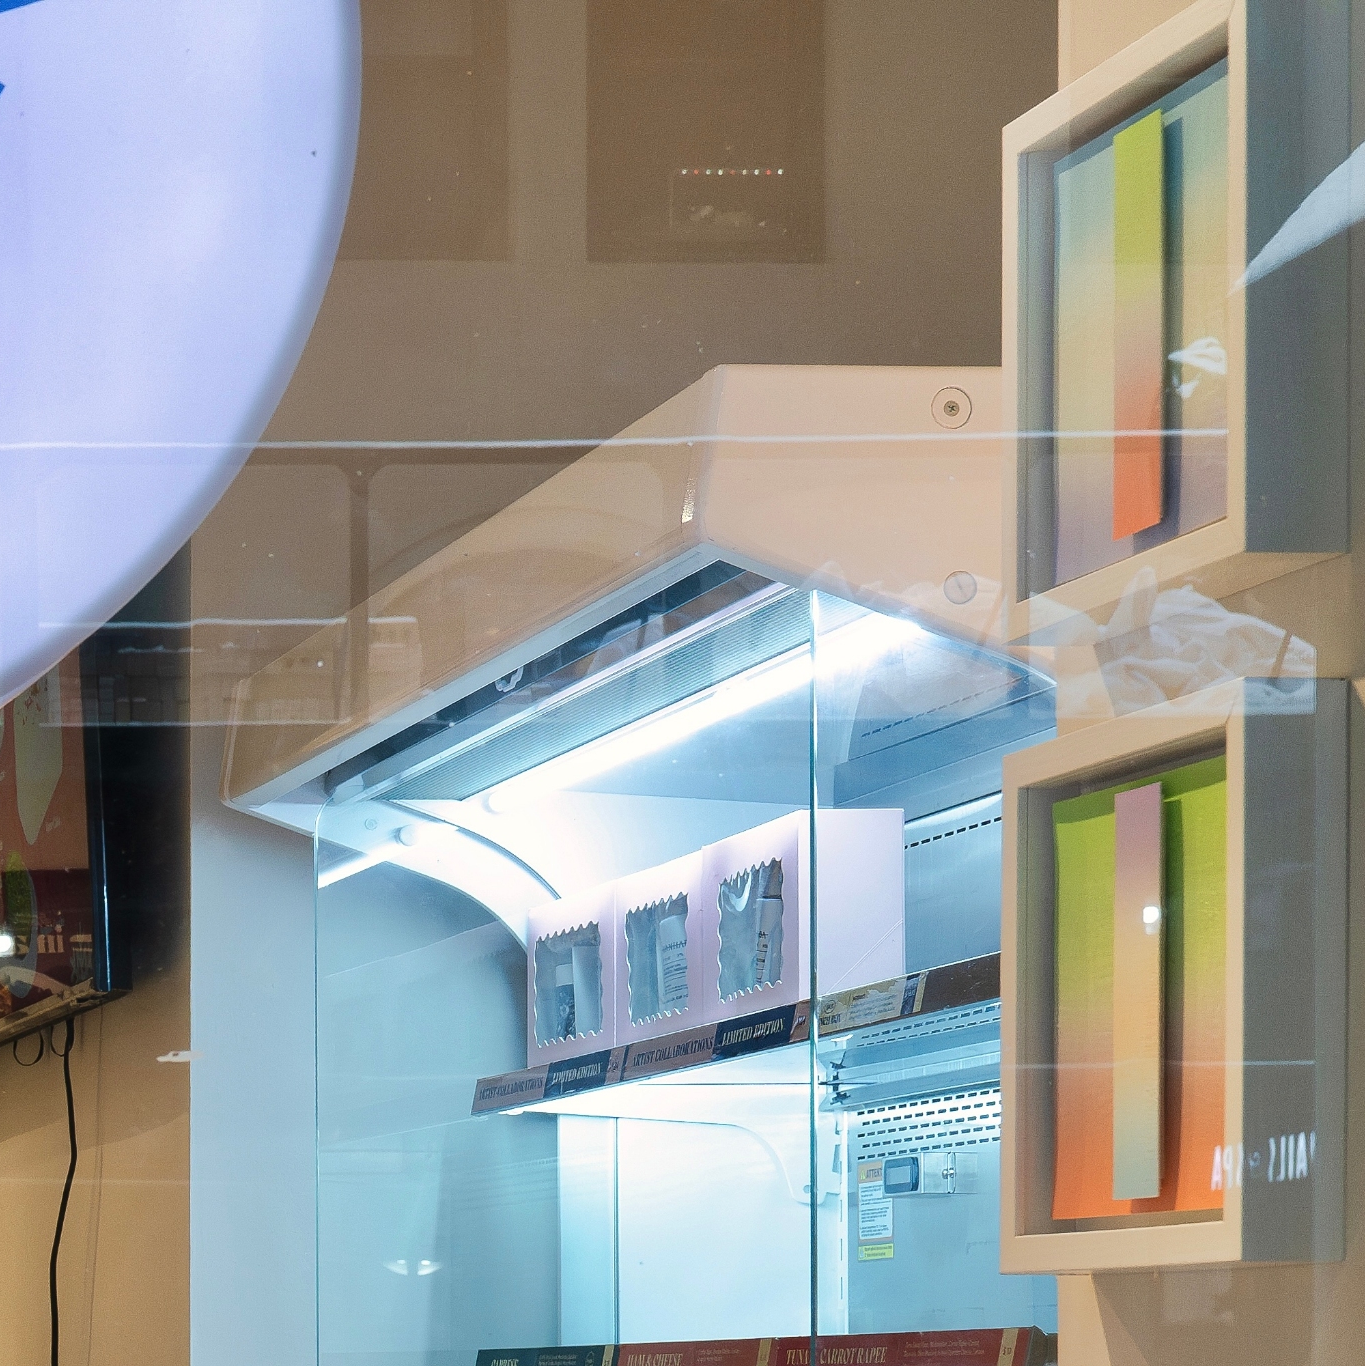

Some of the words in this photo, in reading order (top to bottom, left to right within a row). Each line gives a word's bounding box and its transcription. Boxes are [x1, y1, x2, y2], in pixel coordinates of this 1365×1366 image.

[722, 1026, 753, 1046] LIMITED
[753, 1017, 786, 1039] EDITION
[655, 1036, 715, 1063] COLLABORATIONS
[552, 1068, 578, 1084] LIMITED
[577, 1062, 602, 1080] EDITION
[786, 1349, 810, 1365] TUNA
[820, 1347, 856, 1364] CARROT
